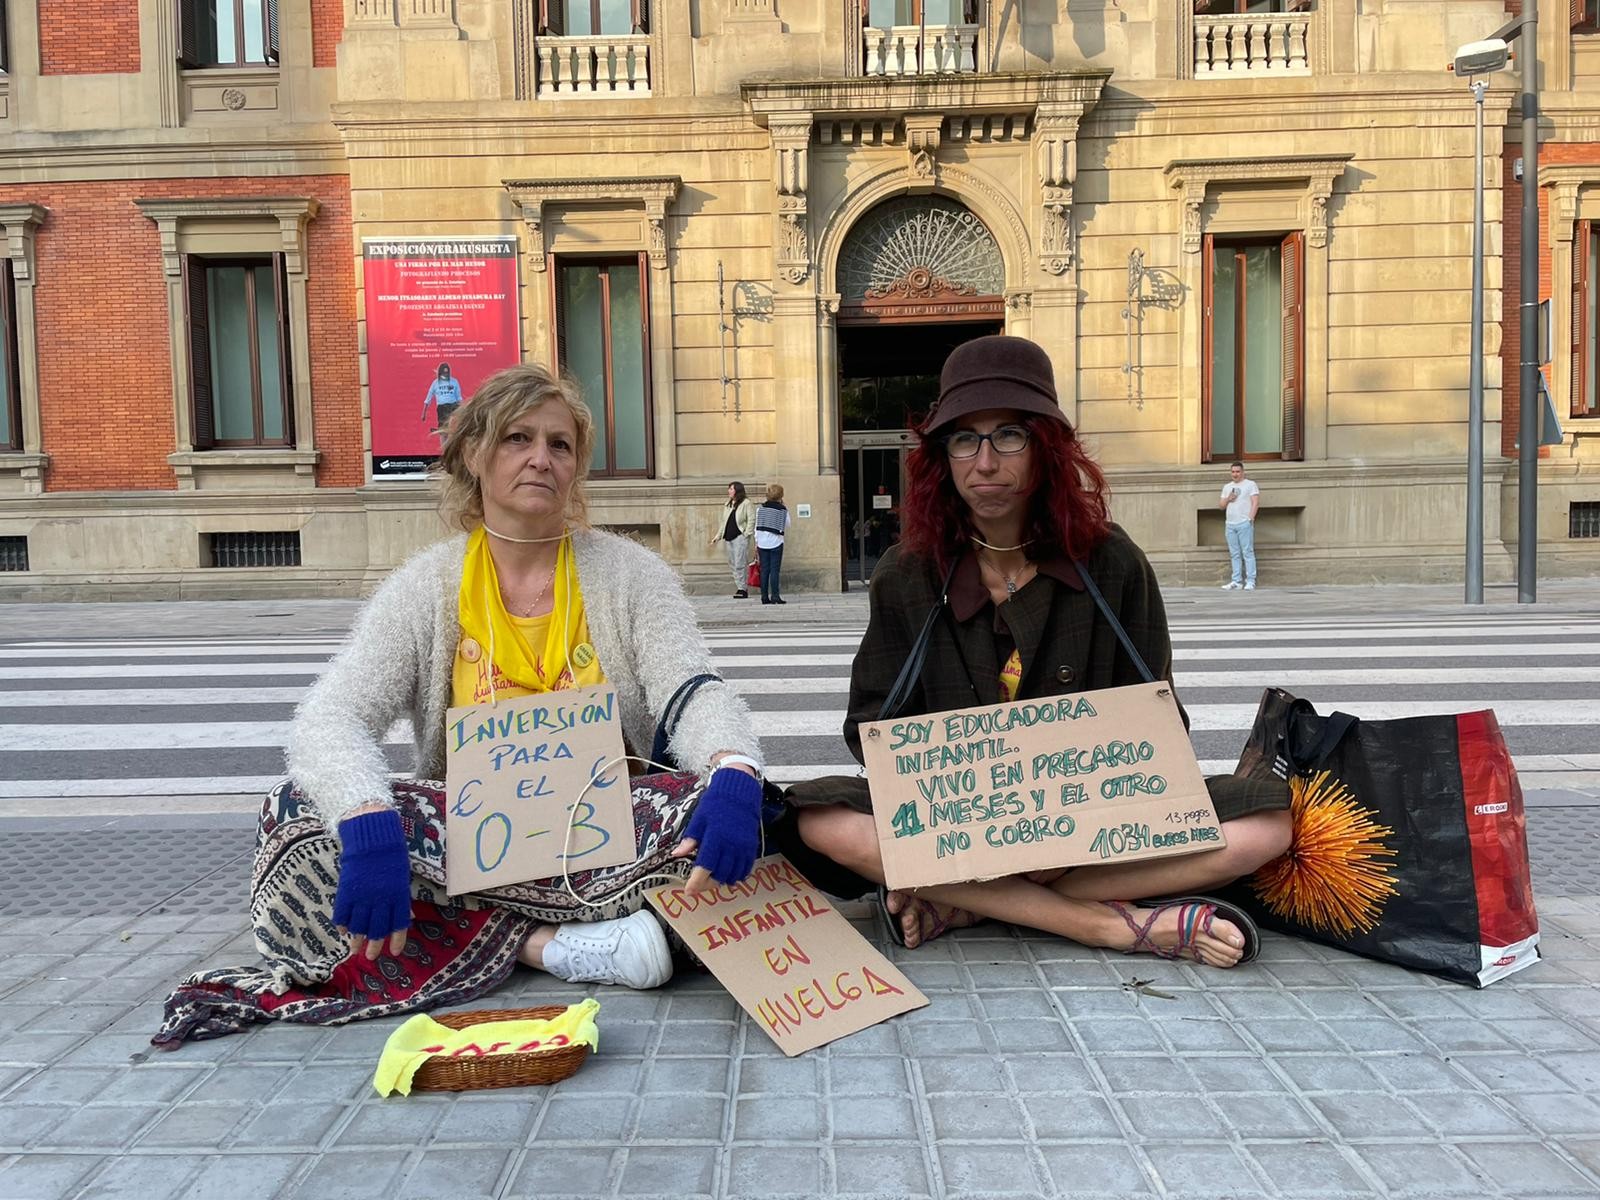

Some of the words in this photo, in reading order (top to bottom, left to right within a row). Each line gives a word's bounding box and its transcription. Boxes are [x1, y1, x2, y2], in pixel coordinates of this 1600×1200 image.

[368, 243, 511, 256] EXPOSICIÓN/ERAKUSKETA
[890, 719, 934, 752] SOY
[945, 697, 1098, 742] EDUCADORA
[488, 742, 574, 772] PARA
[895, 738, 1020, 774] INFANTIL.
[916, 769, 976, 803] VIVO
[990, 761, 1024, 790] EN
[1032, 740, 1155, 781] PRECARIO
[516, 775, 555, 799] EL
[930, 791, 1025, 828] MESES
[1030, 788, 1046, 811] Y
[1061, 782, 1089, 807] EL
[1100, 772, 1168, 800] OTRO
[936, 830, 970, 859] NO
[984, 814, 1076, 849] COBRO
[1165, 811, 1182, 823] 13
[1089, 823, 1151, 858] 1034
[1152, 830, 1189, 848] EUROS
[698, 895, 831, 951] INFANTIL
[764, 934, 811, 976] EN
[756, 965, 905, 1038] HUELGA
